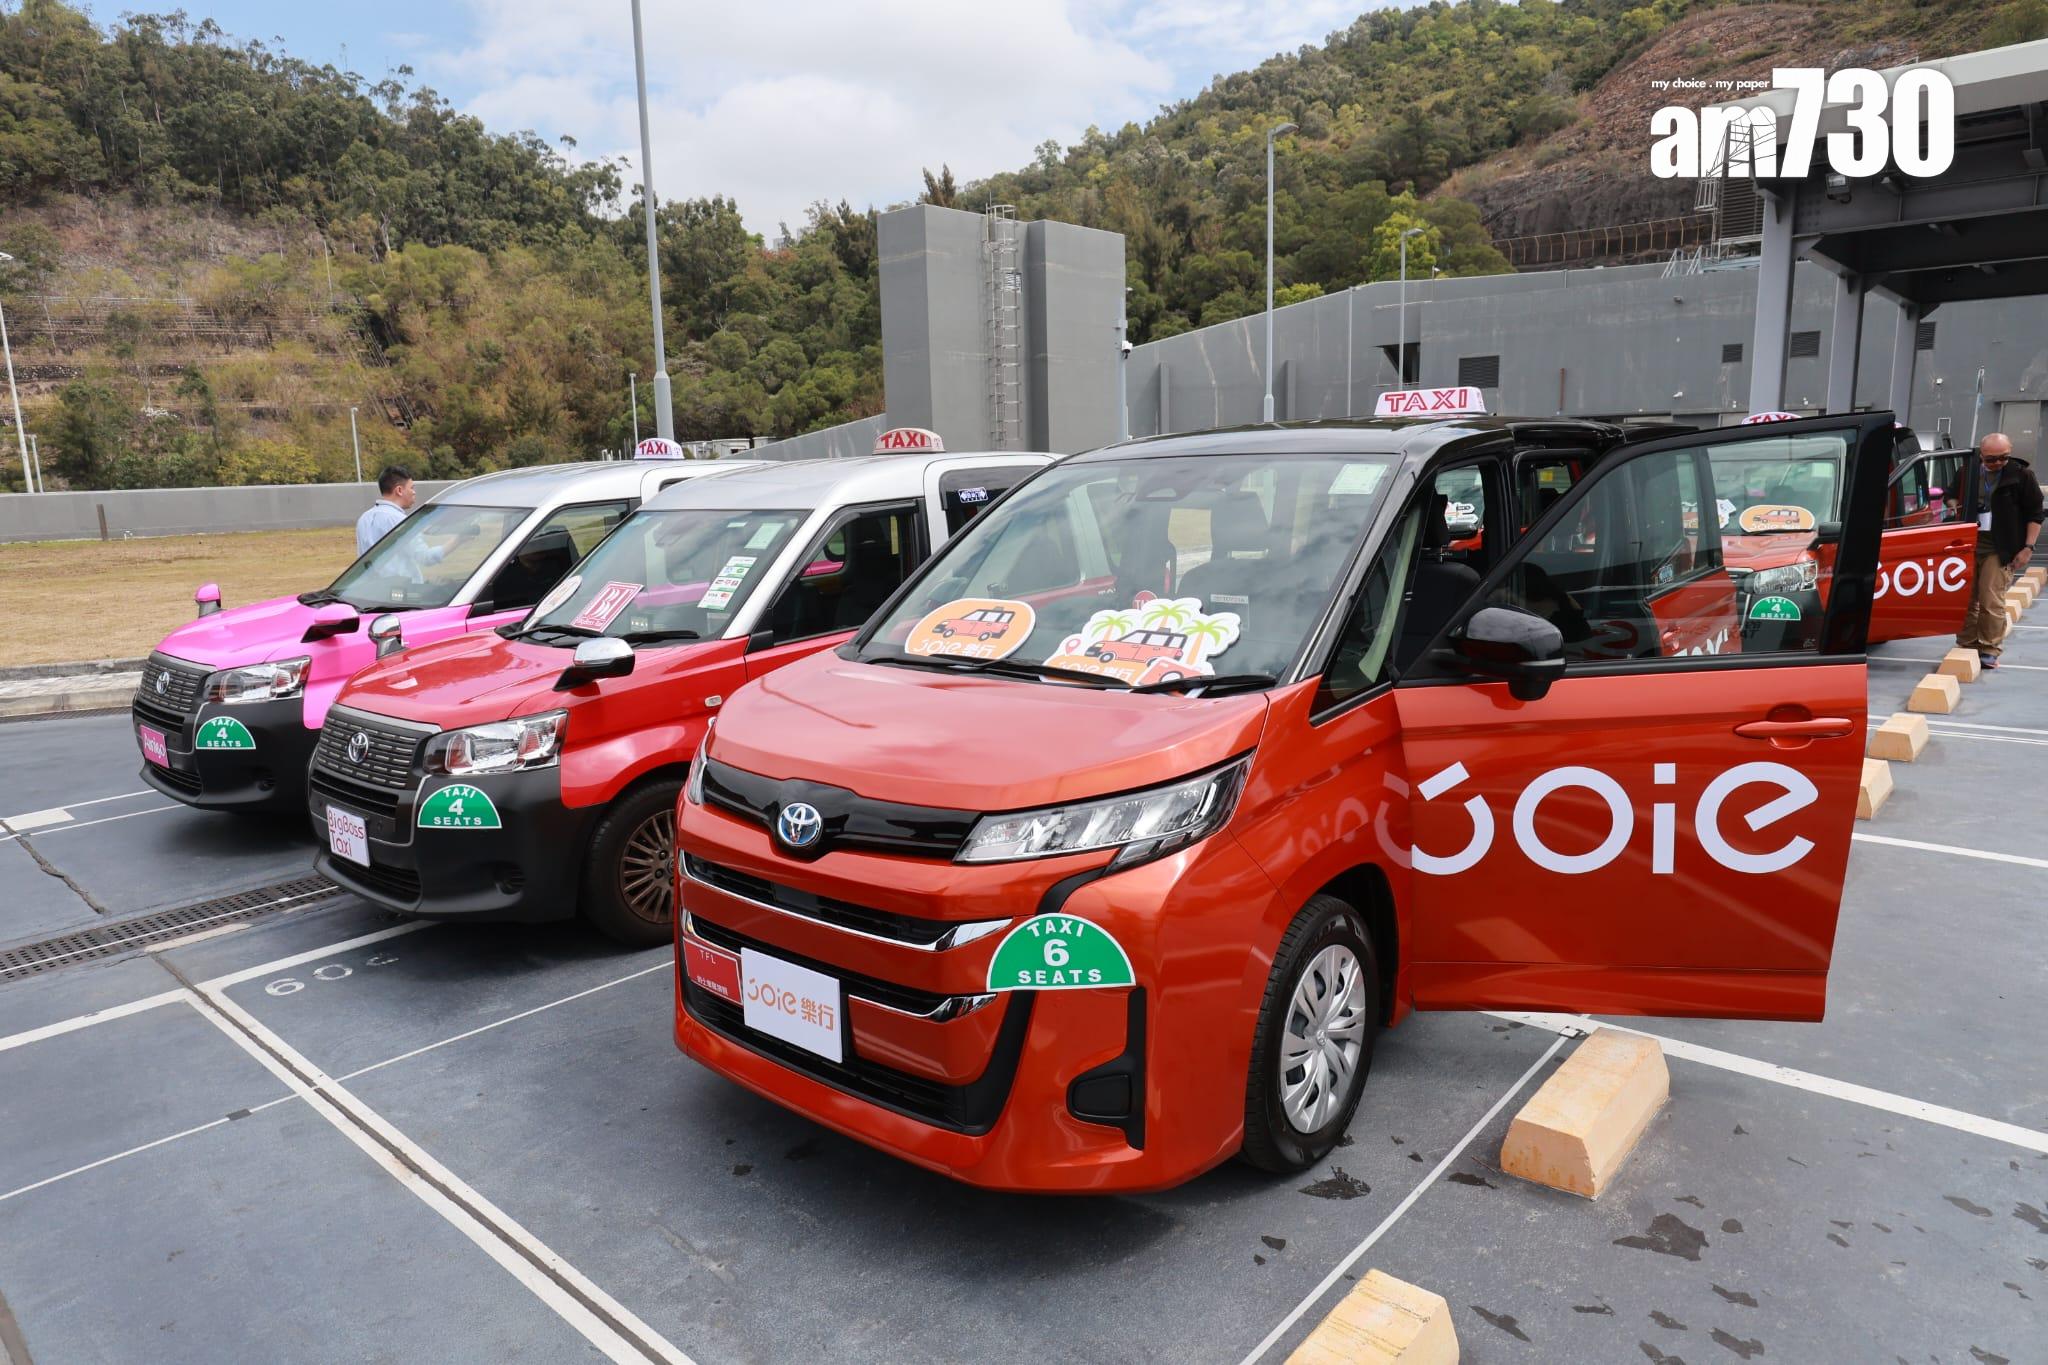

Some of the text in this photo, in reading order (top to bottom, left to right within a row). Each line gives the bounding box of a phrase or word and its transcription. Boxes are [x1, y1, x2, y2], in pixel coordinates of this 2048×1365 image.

[1385, 389, 1468, 413] TAXI
[639, 440, 668, 455] TAXI
[881, 431, 926, 448] TAXI
[1771, 603, 1781, 612] 4
[211, 718, 235, 727] TAXI
[216, 727, 228, 739] 4
[443, 787, 476, 799] TAXI
[448, 798, 464, 815] 4
[328, 810, 365, 840] BigBoss
[433, 816, 482, 826] SEATS
[329, 829, 353, 857] Taxi
[1027, 919, 1085, 938] TAXI
[1043, 939, 1070, 966] 6
[1018, 968, 1102, 984] SEATS
[801, 997, 834, 1031] 樂行
